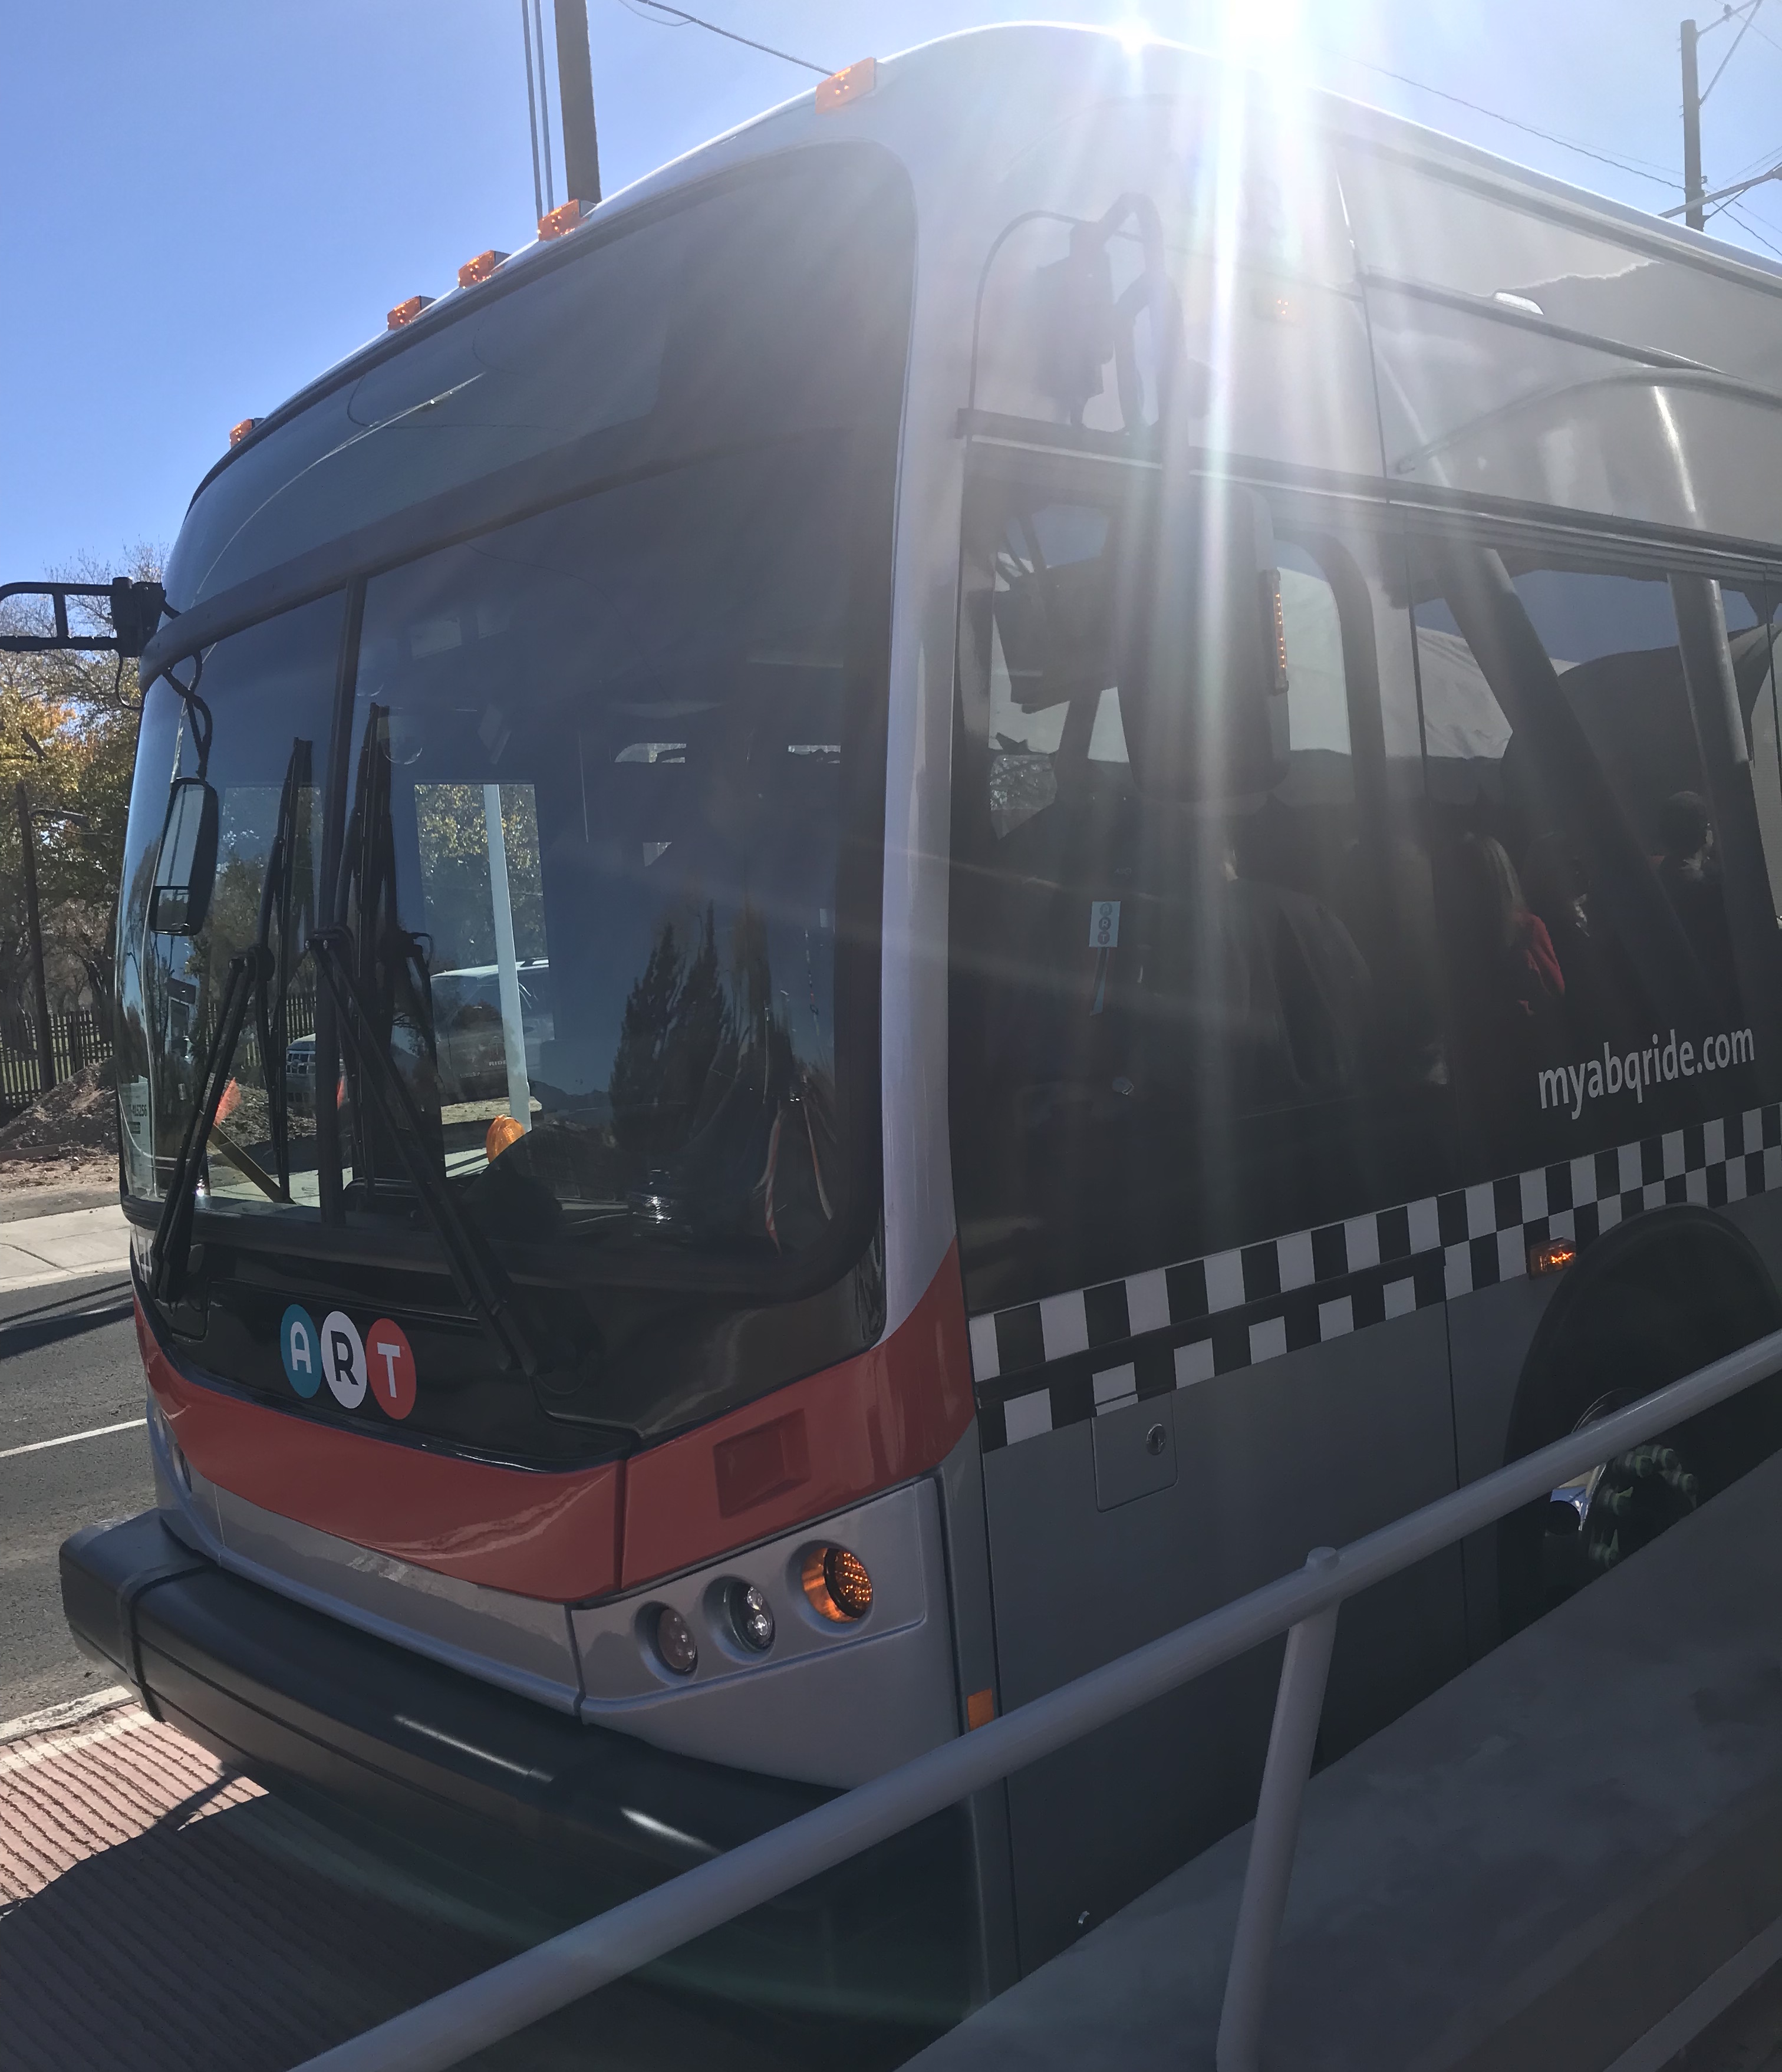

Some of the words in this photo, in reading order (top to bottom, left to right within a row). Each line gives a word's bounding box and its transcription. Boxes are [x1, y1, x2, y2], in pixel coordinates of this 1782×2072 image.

[1100, 904, 1110, 943] ART
[1539, 1029, 1754, 1119] myabqride.com
[288, 1318, 403, 1401] ART
